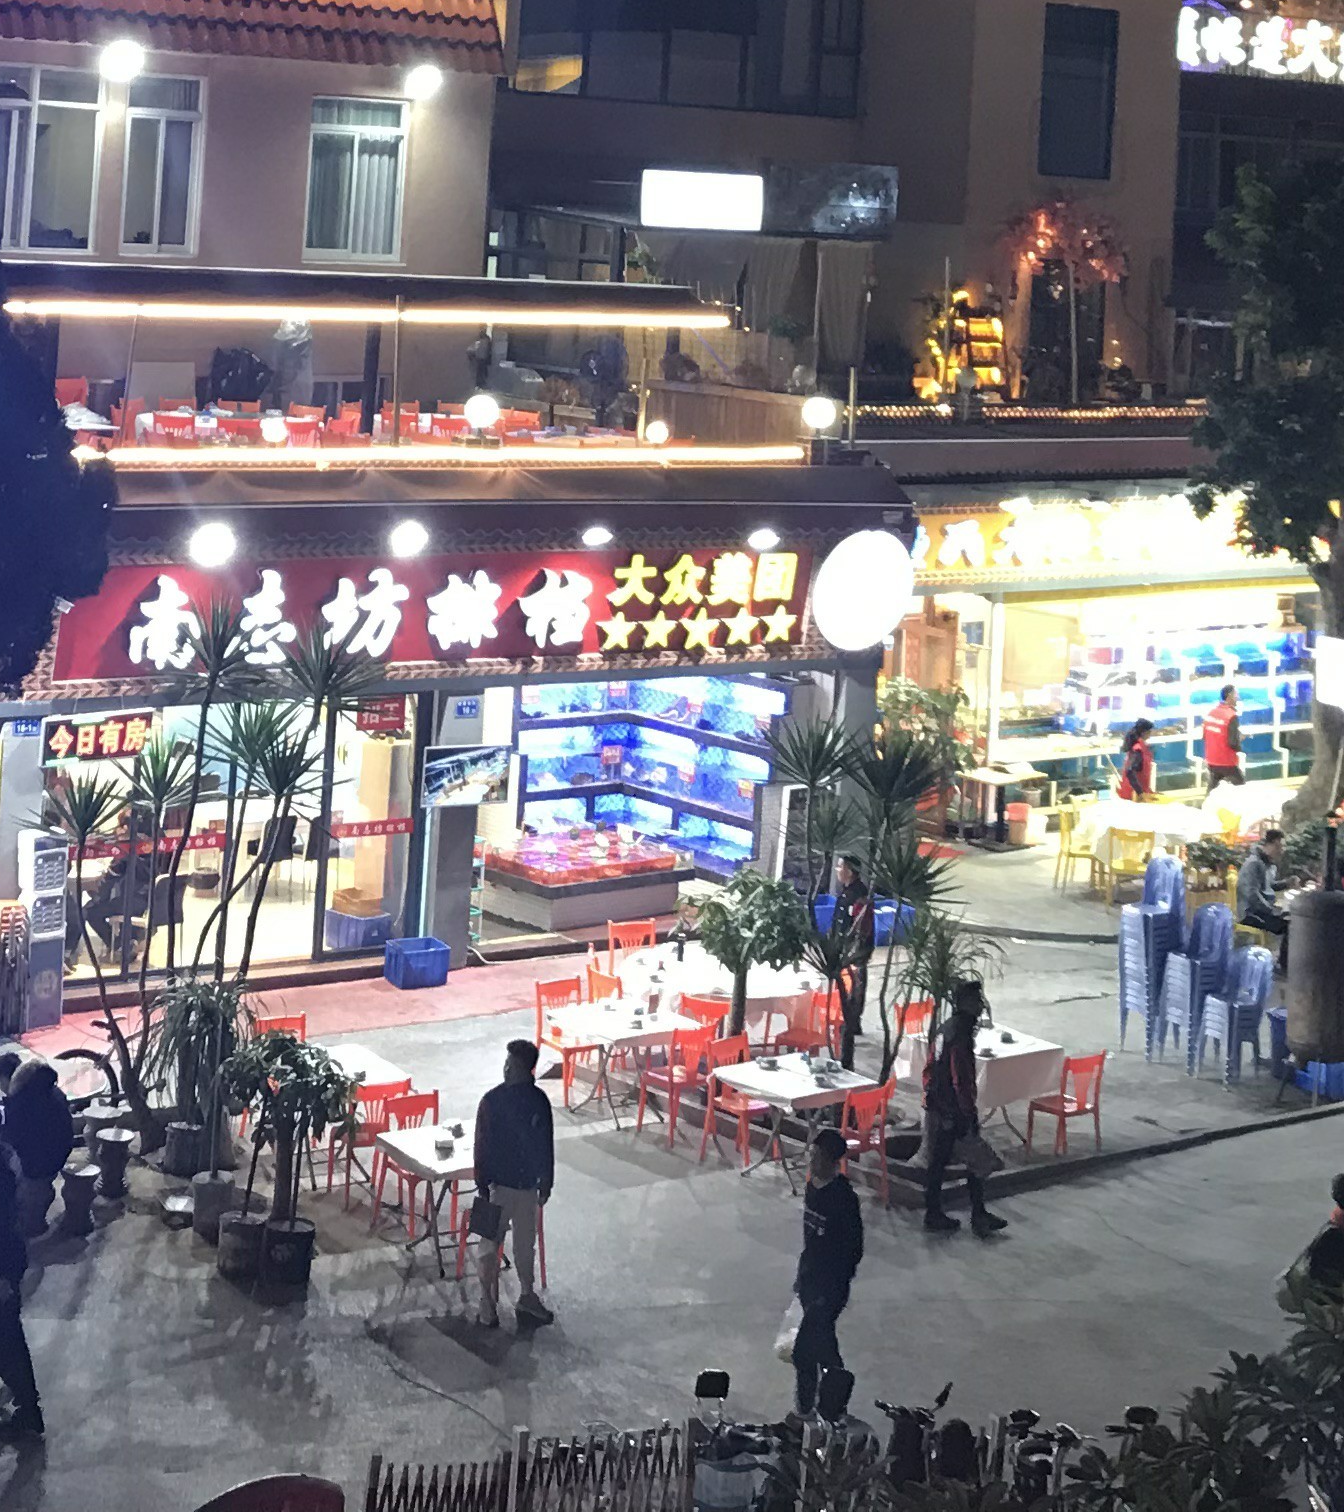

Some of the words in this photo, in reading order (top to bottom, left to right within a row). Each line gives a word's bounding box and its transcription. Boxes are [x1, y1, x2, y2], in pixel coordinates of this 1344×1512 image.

[606, 551, 798, 607] 大众美团
[49, 717, 147, 759] 今日有房
